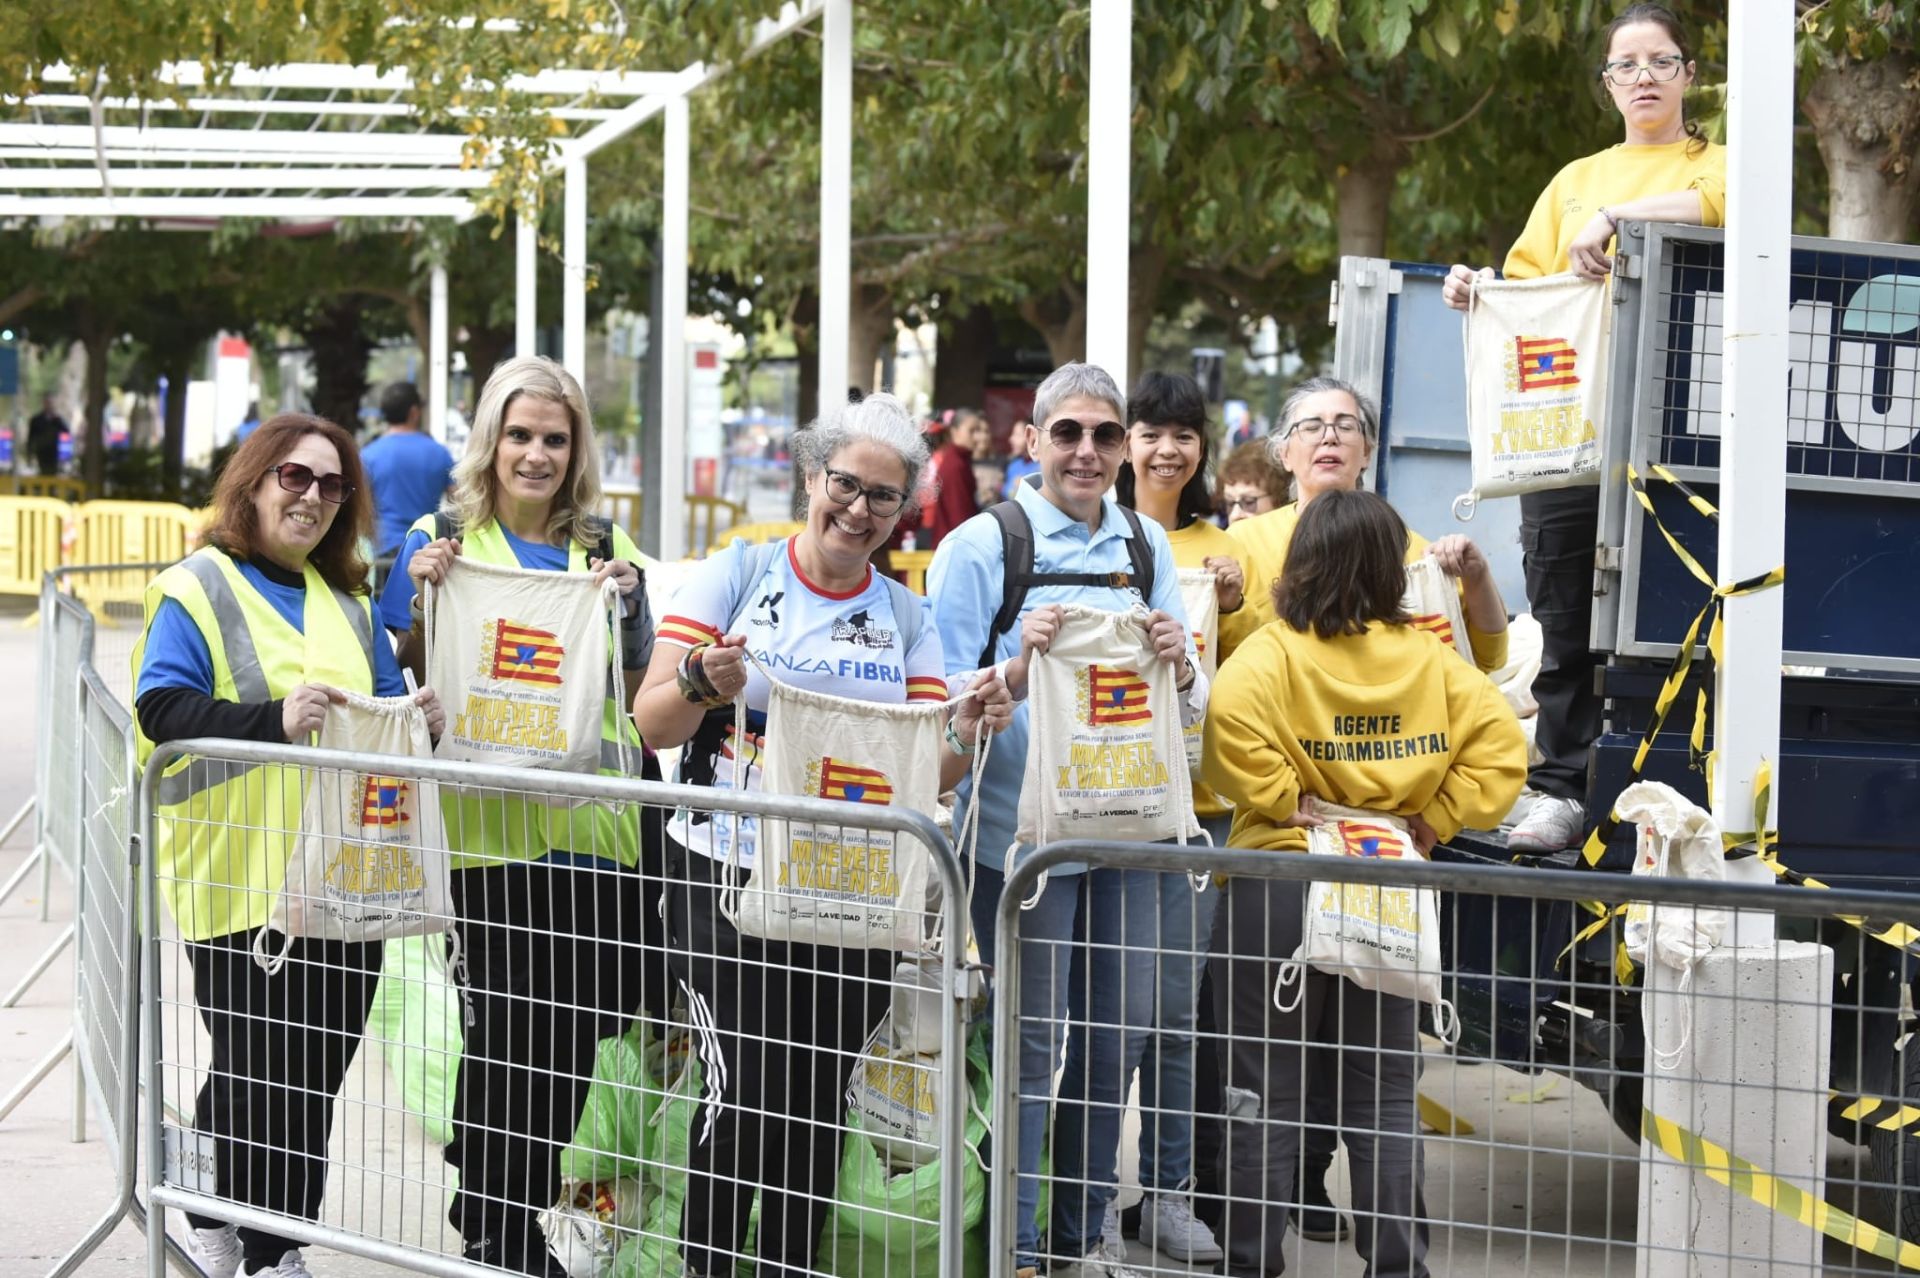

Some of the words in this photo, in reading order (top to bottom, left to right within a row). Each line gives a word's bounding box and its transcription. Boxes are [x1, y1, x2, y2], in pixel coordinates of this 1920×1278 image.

[1492, 432, 1505, 455] X
[838, 659, 903, 684] FIBRA
[452, 713, 466, 738] X
[471, 719, 568, 752] VALENCIA
[1334, 714, 1402, 736] AGENTE
[1056, 766, 1072, 789] X
[1076, 762, 1169, 790] VALENCIA
[326, 863, 337, 885] X
[777, 861, 789, 886] X
[797, 864, 900, 898] VALENCIA
[1320, 892, 1334, 912] X
